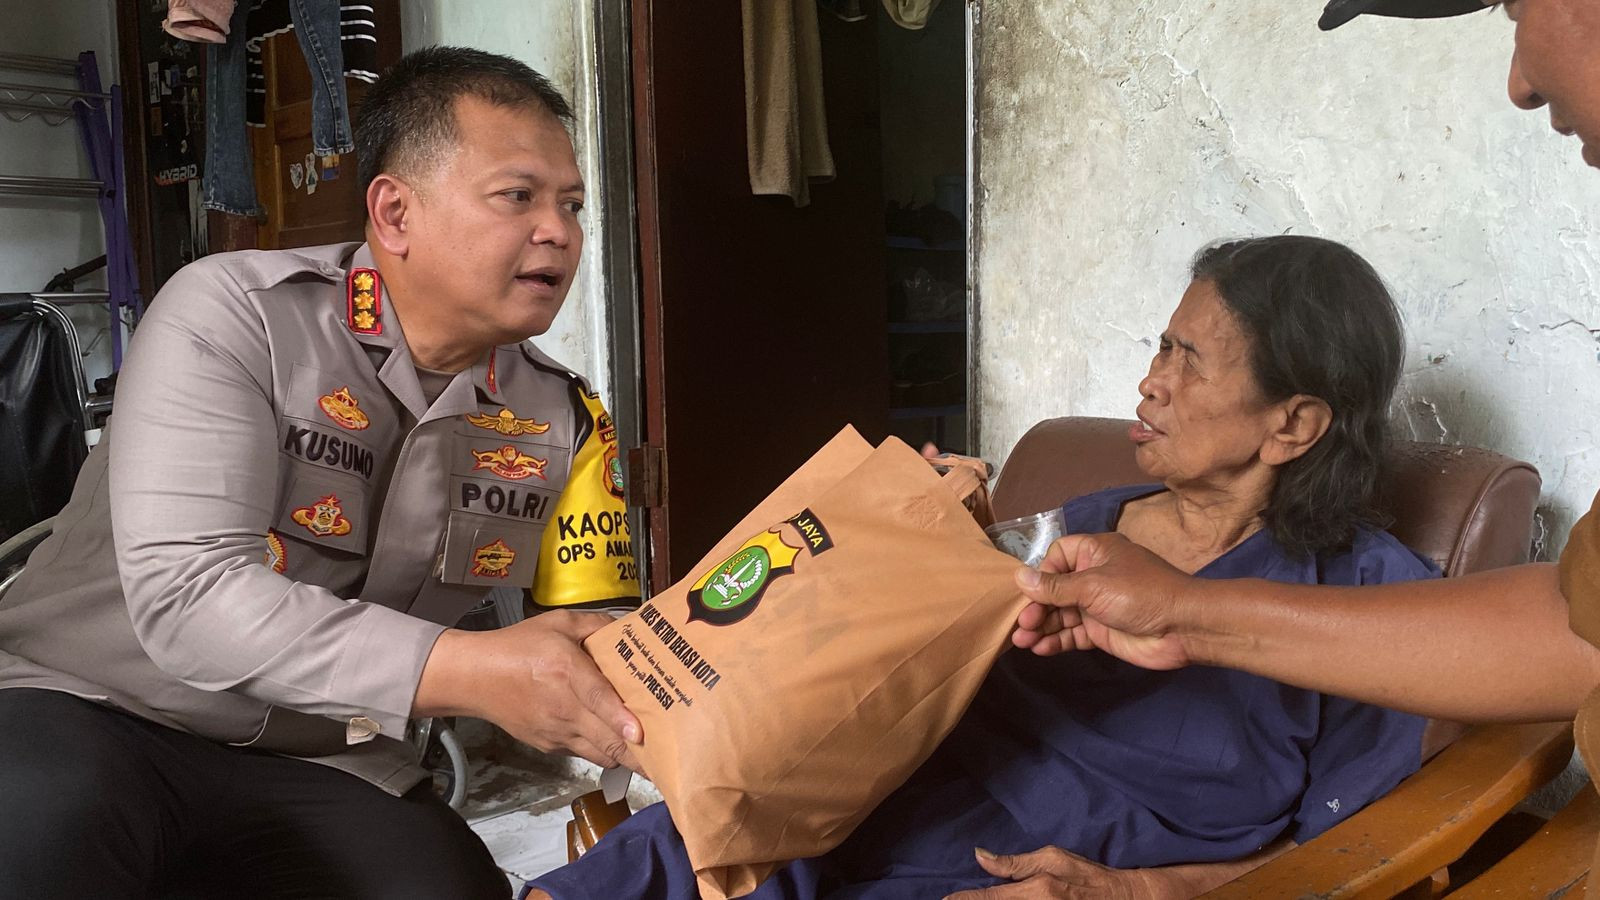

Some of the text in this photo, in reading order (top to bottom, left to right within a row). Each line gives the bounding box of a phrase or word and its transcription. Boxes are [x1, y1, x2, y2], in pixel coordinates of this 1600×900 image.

[159, 163, 198, 181] HYBRID
[284, 424, 374, 480] KUSUMO
[462, 482, 549, 520] POLRI
[557, 510, 631, 541] KAOPS
[797, 518, 824, 548] JAYA
[557, 542, 596, 565] OPS
[651, 616, 678, 646] METRO
[668, 635, 701, 669] BEKASI
[690, 658, 721, 691] KOTA
[614, 638, 634, 662] POLRI
[643, 673, 675, 711] PRESISI
